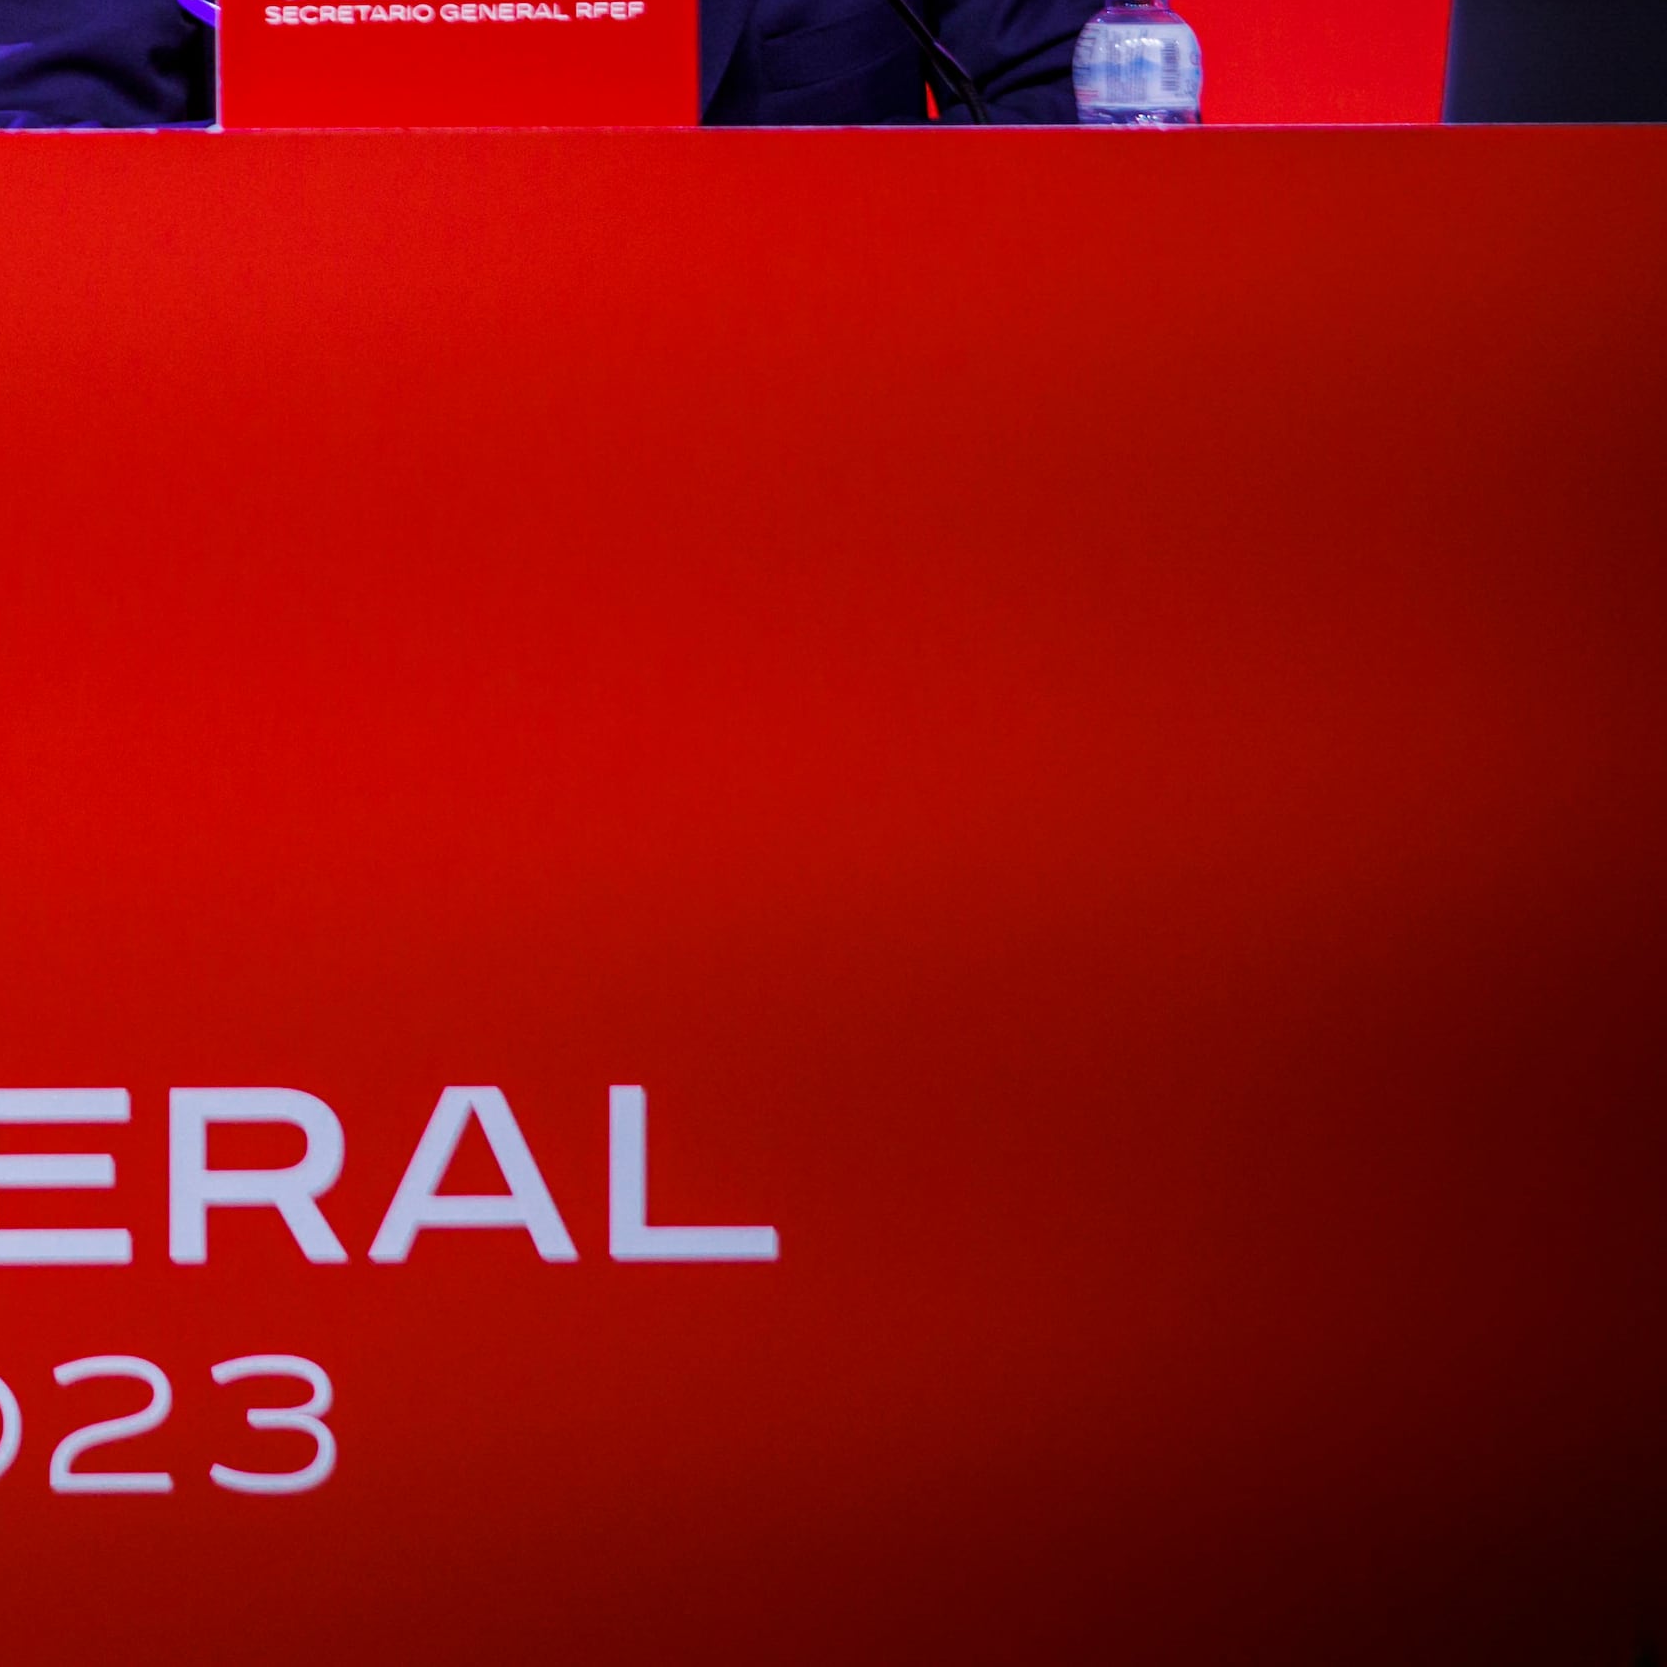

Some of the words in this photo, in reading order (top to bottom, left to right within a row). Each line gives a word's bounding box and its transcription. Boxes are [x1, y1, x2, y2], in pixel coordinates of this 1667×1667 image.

[264, 4, 435, 25] SECRETARIO
[439, 2, 570, 23] GENERAL
[575, 1, 646, 21] RFEF
